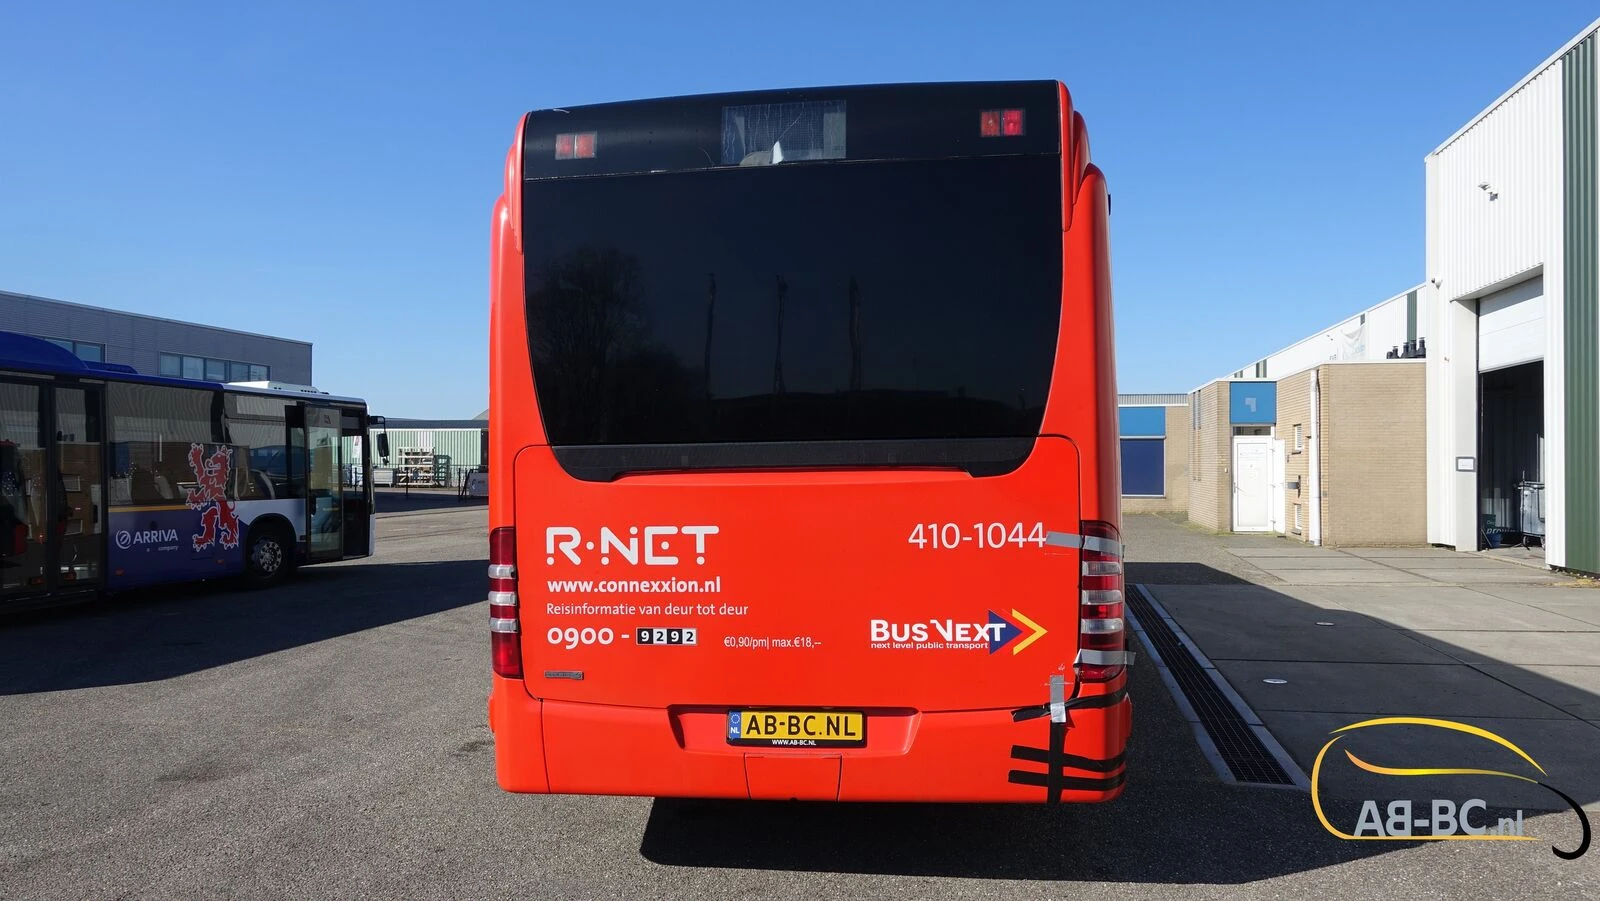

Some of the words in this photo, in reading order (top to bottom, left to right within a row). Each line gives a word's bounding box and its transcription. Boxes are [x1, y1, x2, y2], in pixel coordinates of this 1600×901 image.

[133, 529, 178, 544] ARRIVA
[908, 522, 1047, 549] 410-1044
[547, 576, 721, 593] www.connexxion.nl
[546, 603, 636, 615] Reisinformatie
[639, 606, 661, 615] van
[664, 603, 694, 615] deur
[697, 604, 716, 615] tot
[719, 604, 749, 616] deur
[547, 627, 614, 649] 0900
[640, 630, 695, 643] 9292
[892, 641, 914, 649] level
[916, 641, 943, 650] public
[945, 641, 989, 650] transport
[746, 715, 856, 736] AB-BC.NL
